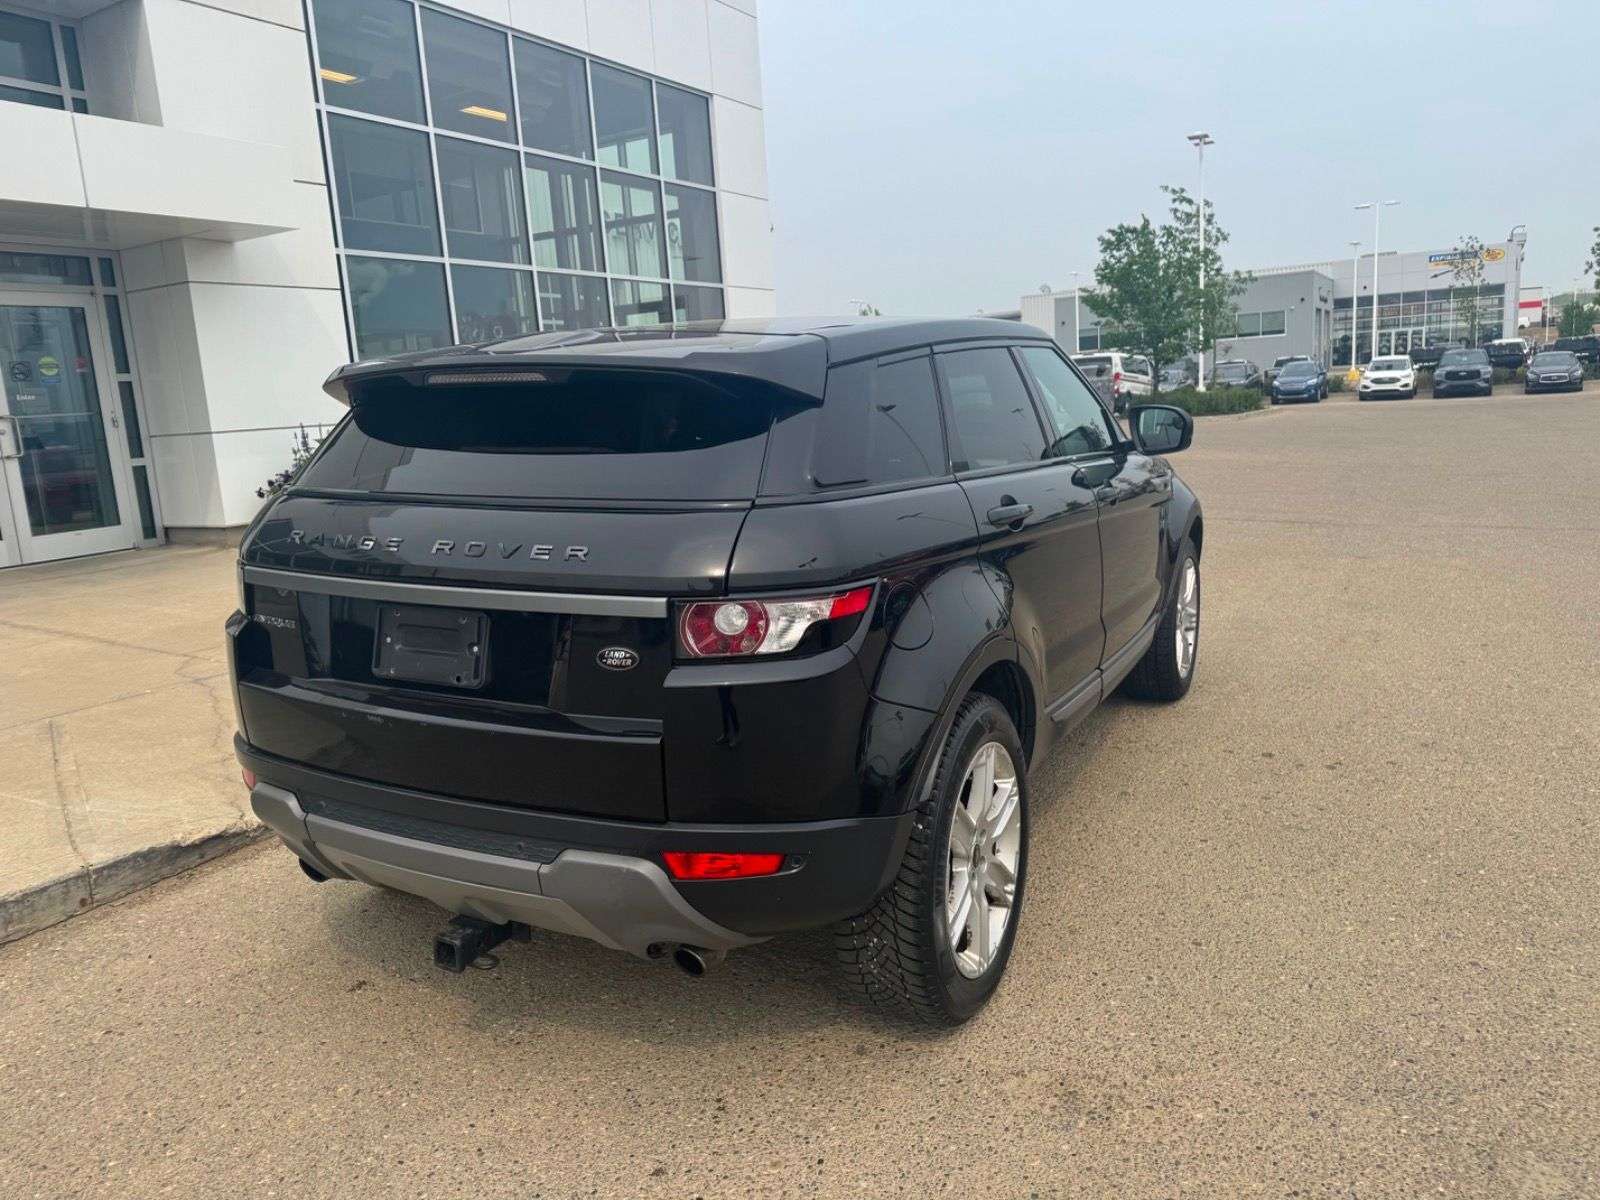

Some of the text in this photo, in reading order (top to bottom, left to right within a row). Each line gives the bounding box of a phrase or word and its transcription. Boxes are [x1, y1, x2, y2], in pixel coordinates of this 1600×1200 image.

[287, 528, 591, 563] RANGE ROVER
[604, 650, 625, 658] LAND
[606, 658, 632, 666] ROVER
